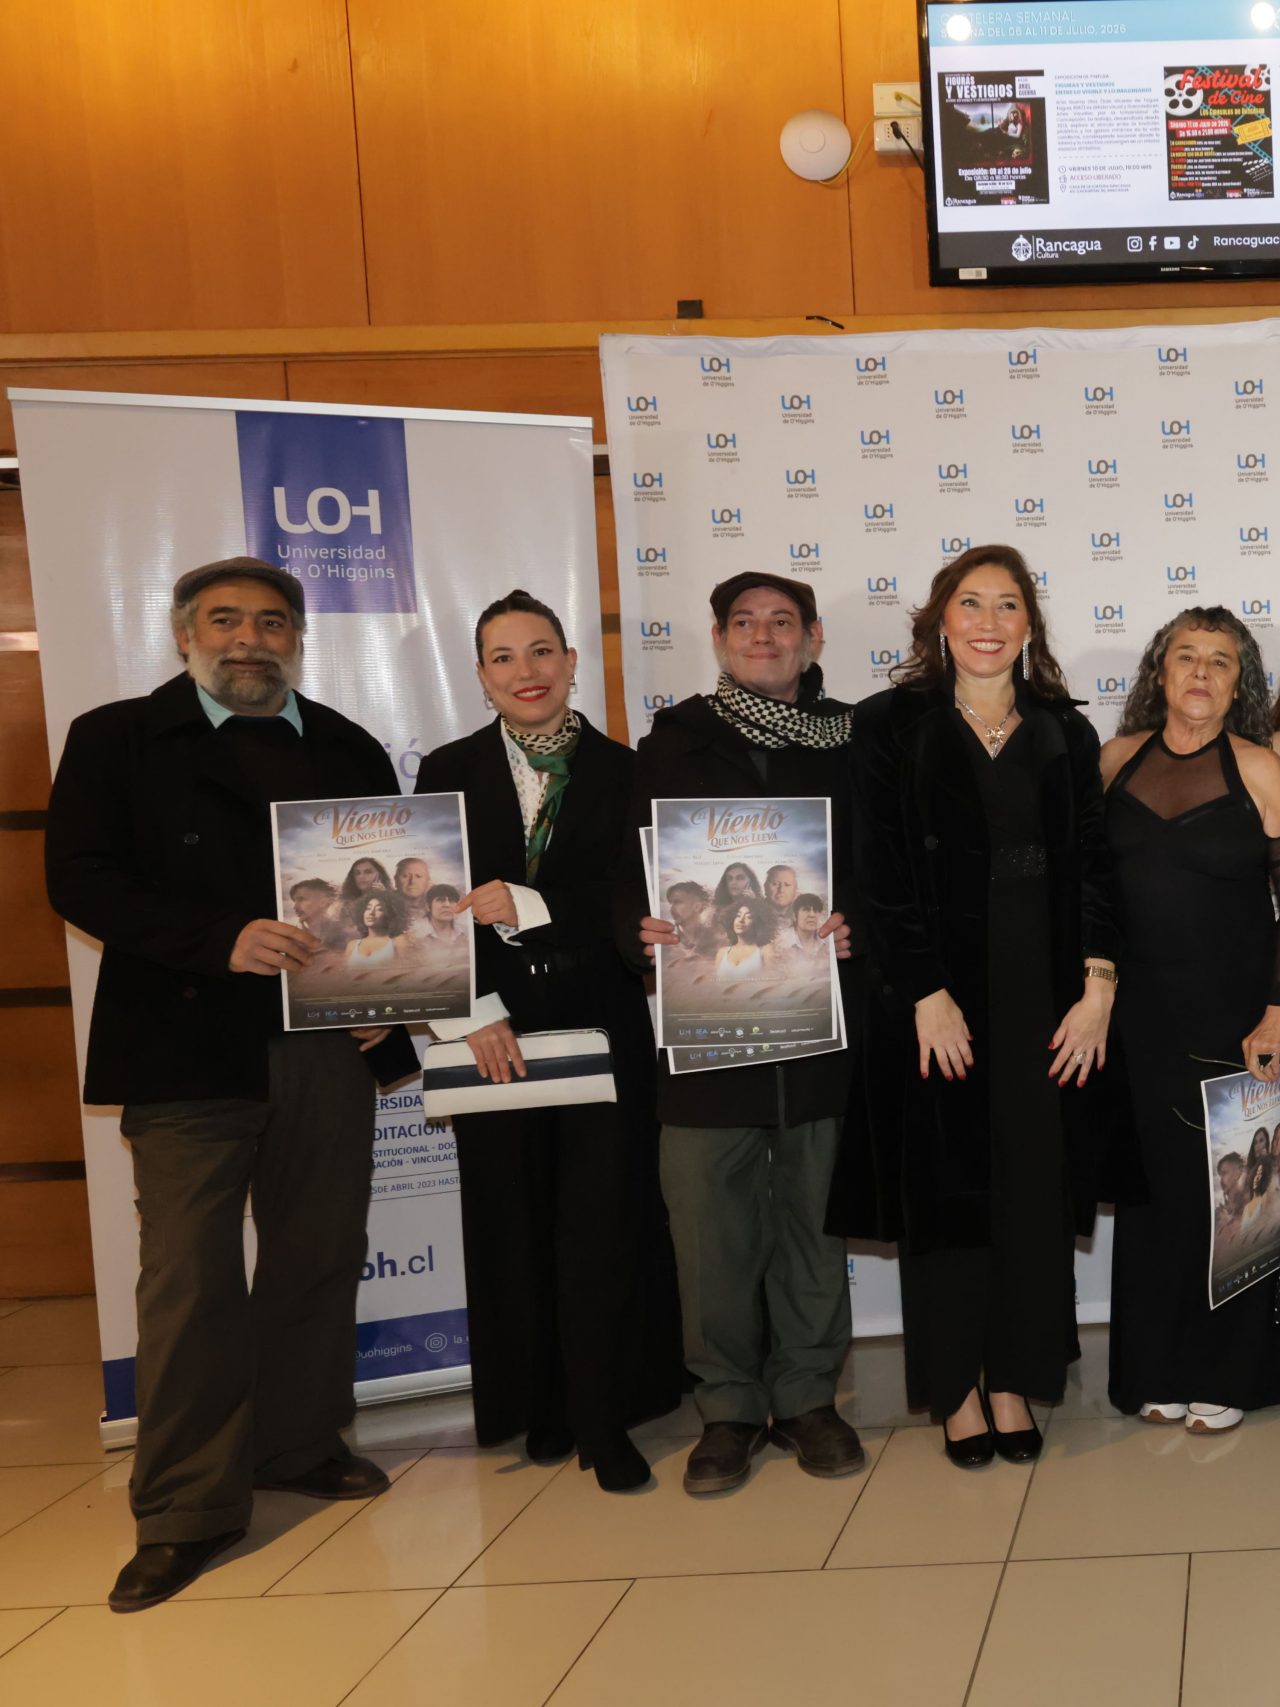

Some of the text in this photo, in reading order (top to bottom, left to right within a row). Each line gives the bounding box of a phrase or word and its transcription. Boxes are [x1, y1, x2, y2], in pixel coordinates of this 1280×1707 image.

[1016, 10, 1076, 24] SEMANAL
[988, 27, 1006, 38] DEL
[1025, 26, 1037, 36] AL
[1049, 26, 1063, 36] DE
[1100, 23, 1127, 34] 2026
[945, 76, 975, 86] FIGURAS
[1180, 67, 1263, 90] Festival
[945, 84, 1013, 99] Y VESTIGIOS
[1208, 90, 1265, 105] de Cine
[1035, 237, 1102, 255] Rancagua
[1009, 349, 1036, 365] UOH
[701, 357, 730, 373] UOH
[935, 390, 963, 405] UOH
[1085, 387, 1113, 401] UOH
[627, 396, 657, 412] UOH
[781, 395, 810, 410] UOH
[707, 433, 736, 448] UOH
[861, 430, 889, 445] UOH
[1237, 454, 1265, 469] UOH
[1165, 493, 1192, 508] UOH
[273, 486, 382, 534] UOH
[1240, 527, 1267, 542] UOH
[277, 544, 386, 560] Universidad
[637, 548, 666, 562] UOH
[790, 544, 819, 558] UOH
[308, 564, 395, 581] O'Higgins
[868, 577, 896, 592] UOH
[1095, 605, 1122, 620] UOH
[641, 622, 670, 637] UOH
[320, 802, 414, 839] Viento
[700, 805, 788, 842] Viento
[336, 828, 406, 845] QUE NOS LLEVA
[711, 832, 778, 848] QUE NOS LLEVA
[375, 1095, 423, 1111] ERSIDA
[373, 1142, 457, 1158] STITUCIONAL DOC
[372, 1153, 457, 1169] ACIÓN VINCULACI
[371, 1177, 460, 1195] SDE ABRIL 2023 HAST
[359, 1245, 434, 1281] oh.cl
